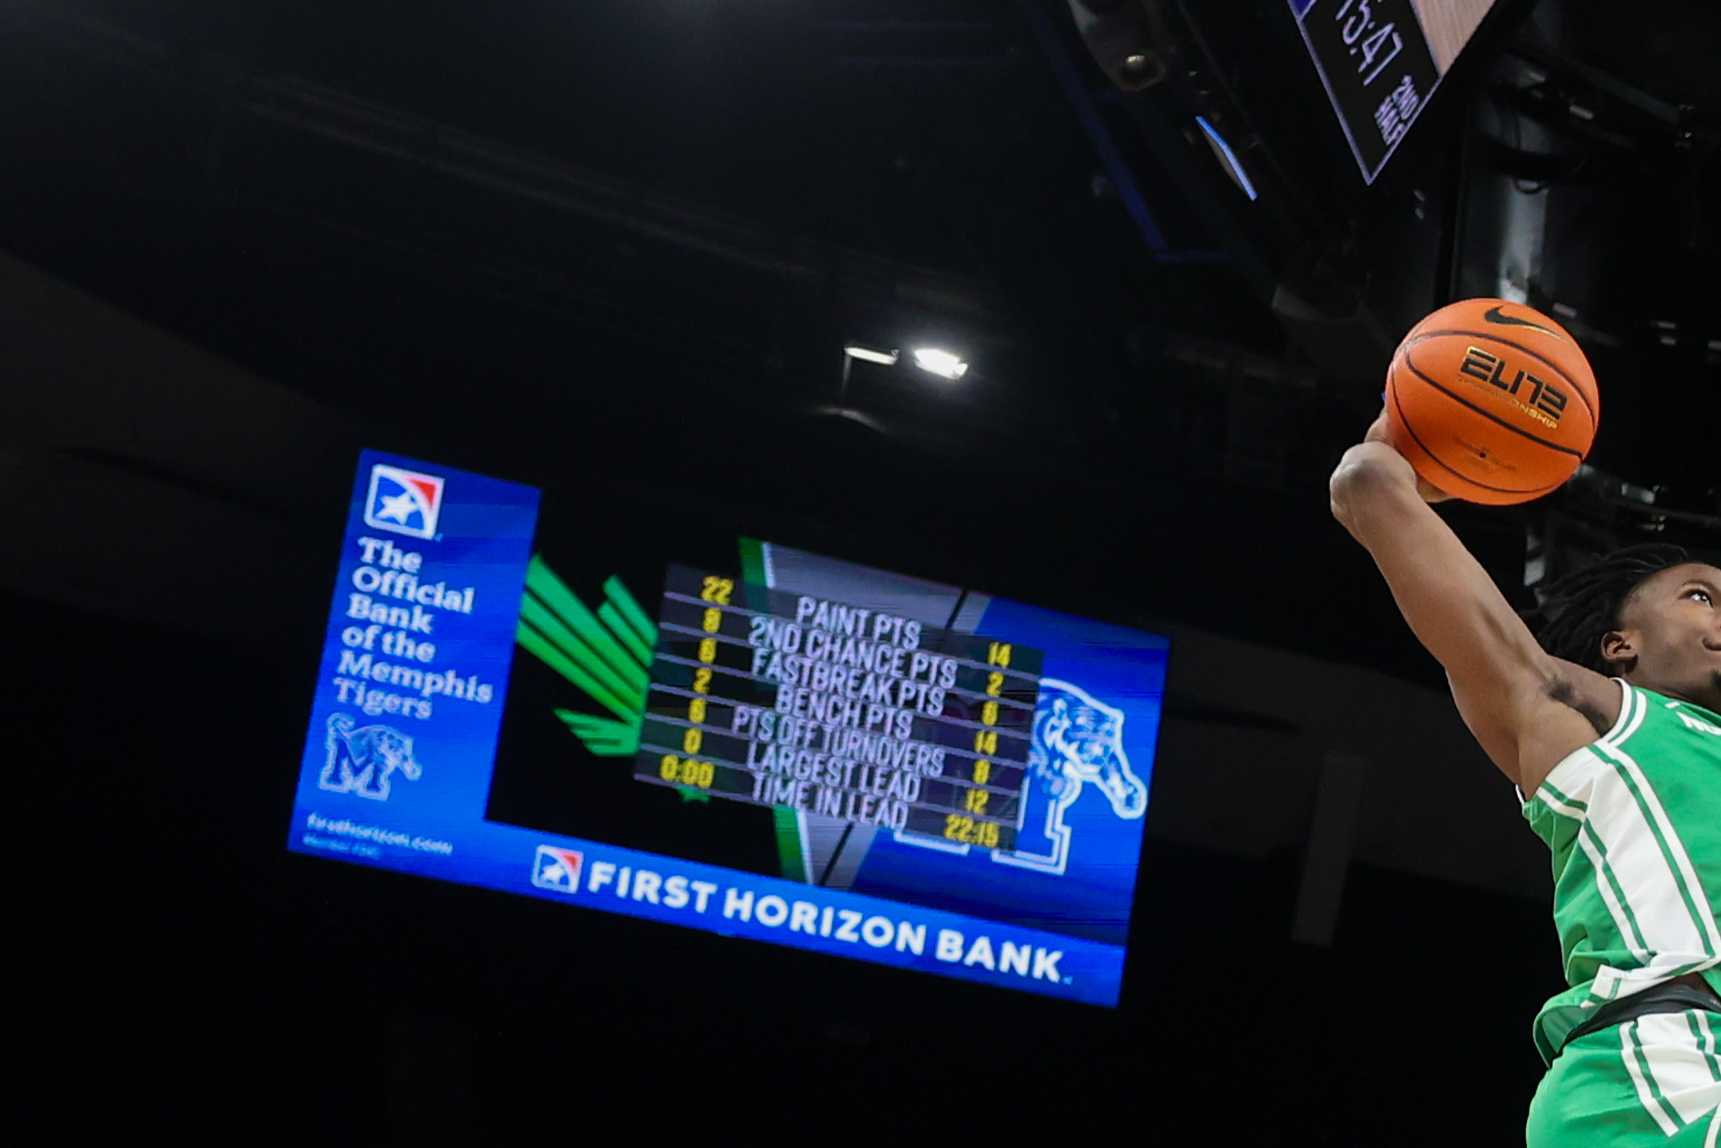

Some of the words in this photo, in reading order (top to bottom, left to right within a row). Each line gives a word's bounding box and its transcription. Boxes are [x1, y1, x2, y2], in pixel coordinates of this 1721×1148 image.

[1461, 346, 1568, 421] ELITE
[358, 536, 422, 573] The
[346, 593, 434, 634] Bank
[352, 566, 475, 614] Official
[702, 576, 733, 606] 22
[341, 625, 382, 650] of
[382, 631, 436, 663] the
[797, 597, 870, 638] PAINT
[873, 614, 922, 650] PTS
[336, 650, 494, 703] Memphis
[749, 616, 801, 653] 2ND
[805, 630, 906, 678] CHANCE
[910, 653, 957, 689] PTS
[333, 677, 432, 720] Tigers
[693, 667, 712, 694] 2
[752, 648, 895, 705] FASTBREAK
[899, 680, 946, 716] PTS
[986, 672, 1003, 697] 2
[776, 684, 861, 727] BENCH
[866, 704, 914, 740] PTS
[732, 706, 776, 741] PTS
[778, 715, 820, 748] OFF
[821, 724, 946, 777] TURNOVERS
[661, 754, 714, 789] 0:00
[748, 741, 856, 786] LARGEST
[860, 766, 921, 802] LEAD
[752, 772, 812, 812] TIME
[816, 785, 840, 818] IN
[847, 792, 909, 830] LEAD
[588, 862, 717, 914] FIRST
[723, 888, 926, 956] HORIZON
